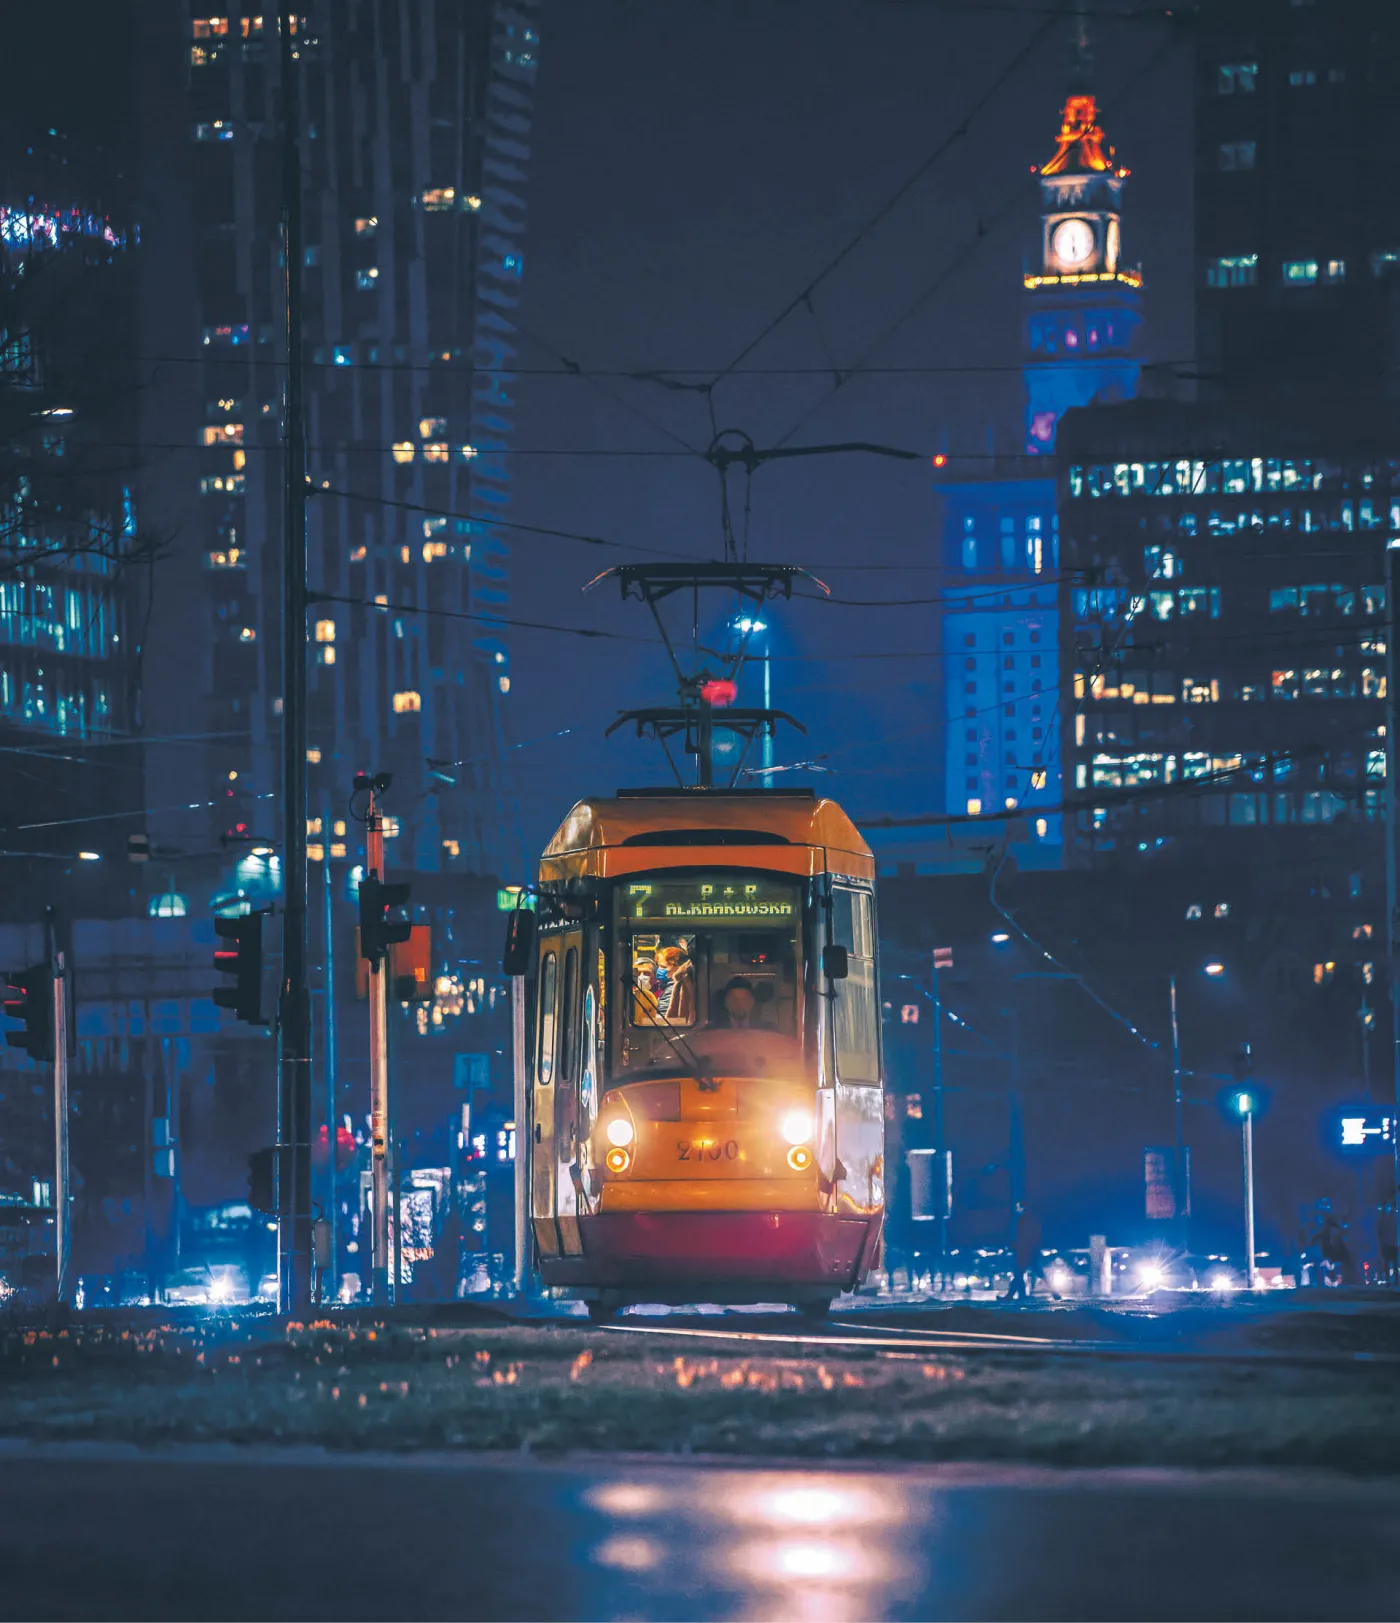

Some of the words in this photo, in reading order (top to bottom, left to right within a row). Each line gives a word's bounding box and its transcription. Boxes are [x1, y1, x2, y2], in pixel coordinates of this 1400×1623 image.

[629, 885, 652, 917] 7
[701, 884, 713, 901] P
[745, 884, 757, 901] R
